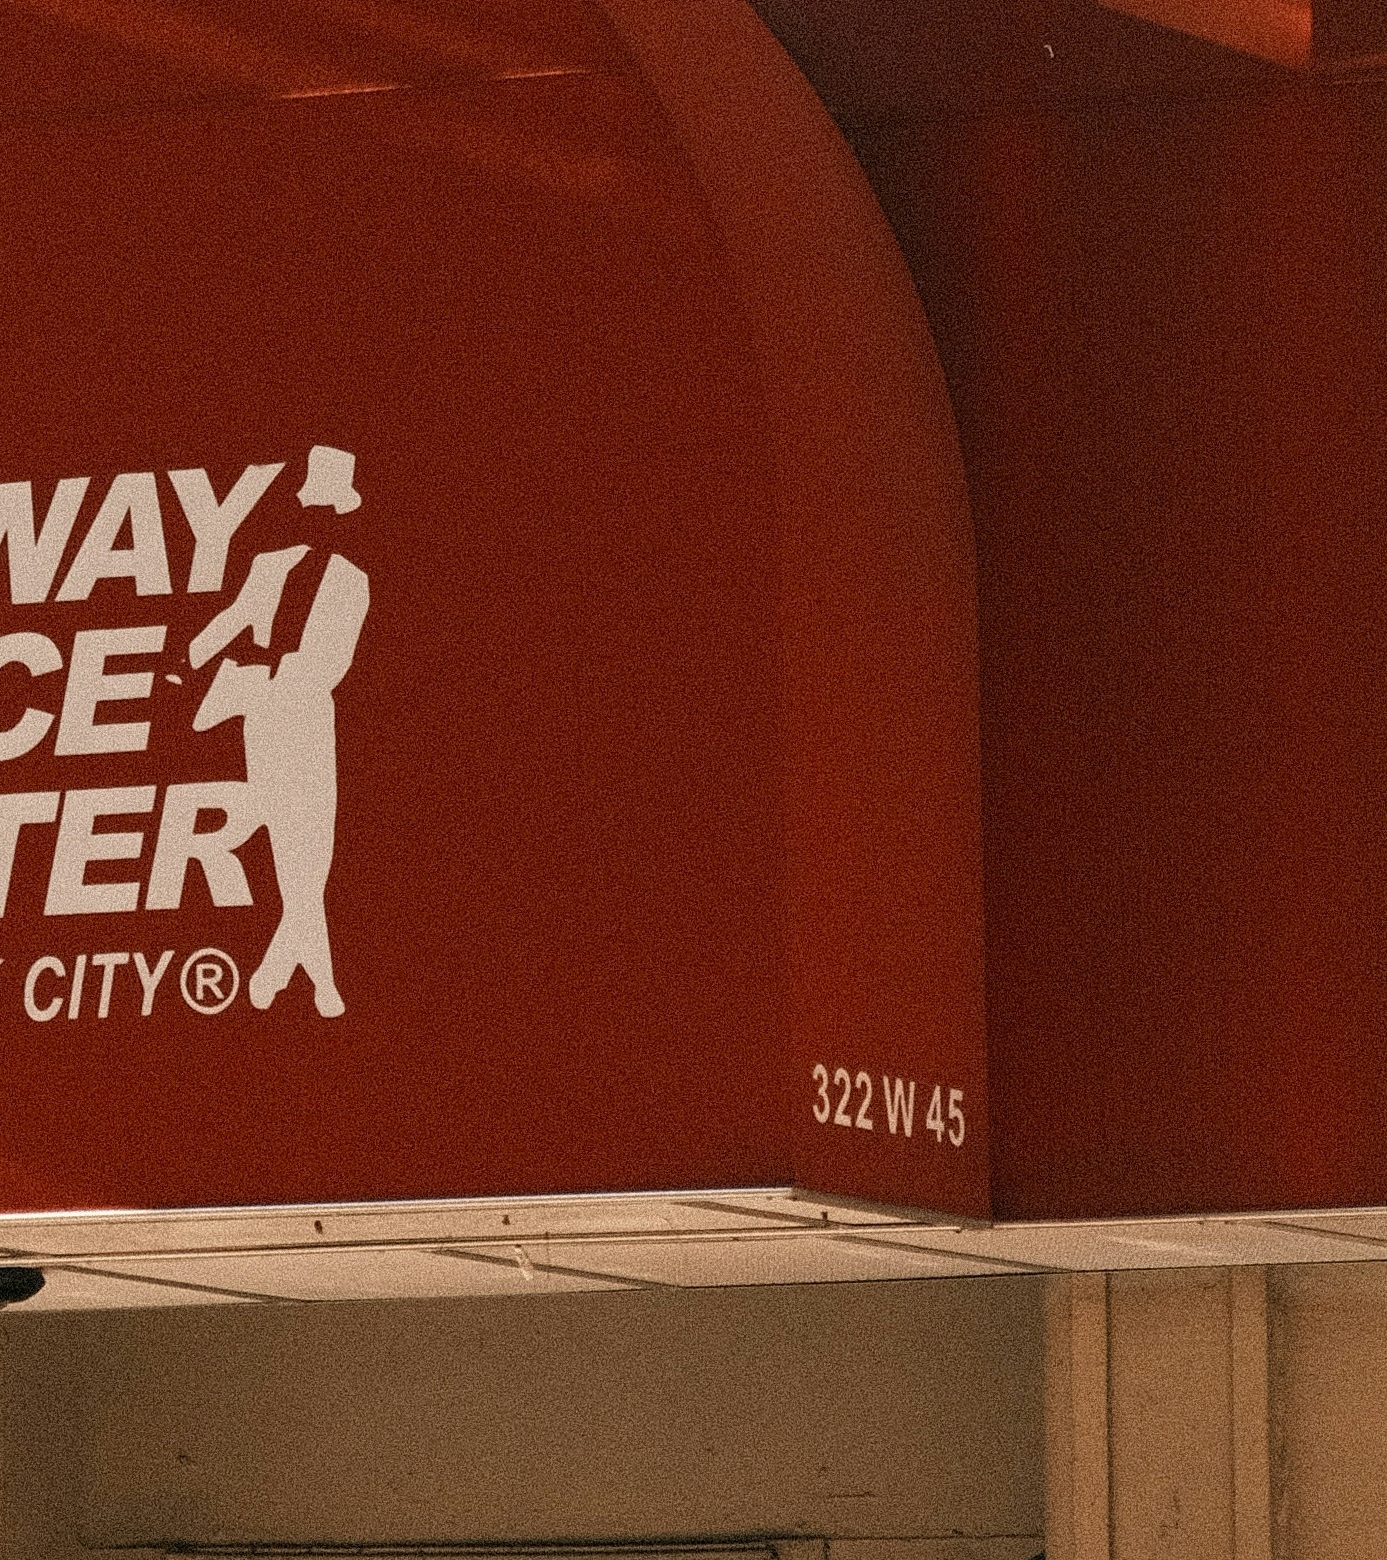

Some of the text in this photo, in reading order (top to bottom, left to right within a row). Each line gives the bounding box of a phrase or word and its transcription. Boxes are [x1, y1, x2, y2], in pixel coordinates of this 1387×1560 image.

[813, 1064, 965, 1147] 322 W 45
